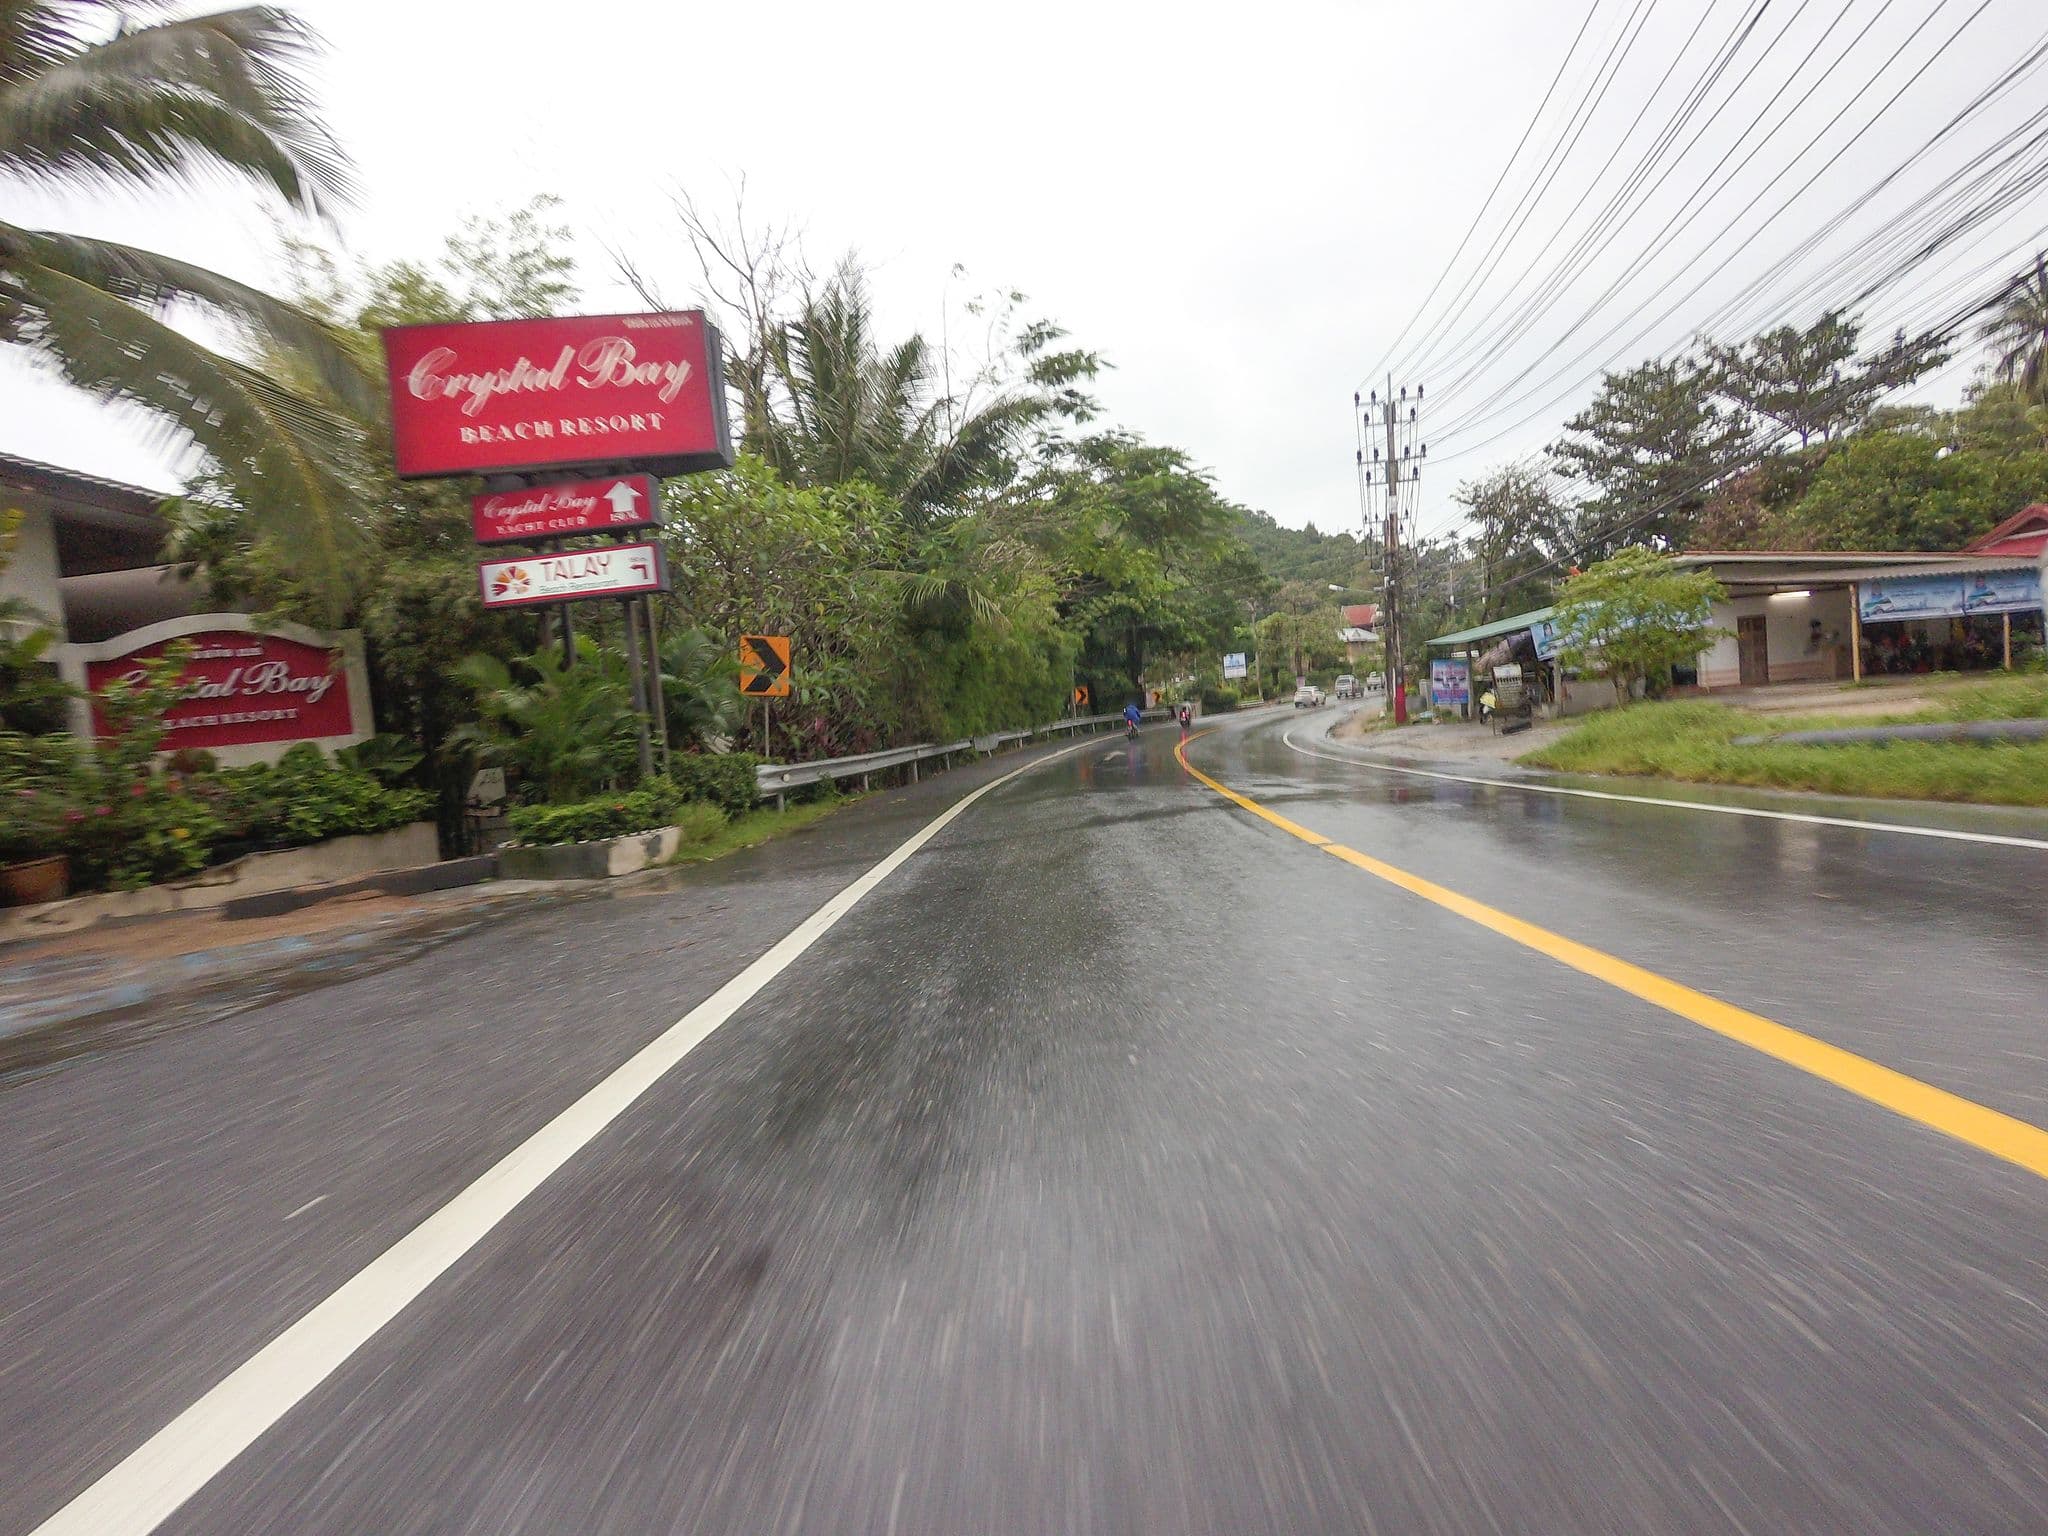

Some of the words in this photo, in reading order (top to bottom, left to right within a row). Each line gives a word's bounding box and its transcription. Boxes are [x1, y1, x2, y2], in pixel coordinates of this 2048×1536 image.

[403, 345, 576, 417] Crystal
[576, 336, 693, 404] Bay
[460, 419, 554, 444] BEACH
[558, 411, 666, 437] RESORT
[483, 493, 552, 524] Crystal
[549, 493, 598, 515] Bay
[539, 554, 611, 582] TALAY
[243, 661, 334, 703] Bay
[221, 708, 299, 724] RESORT
